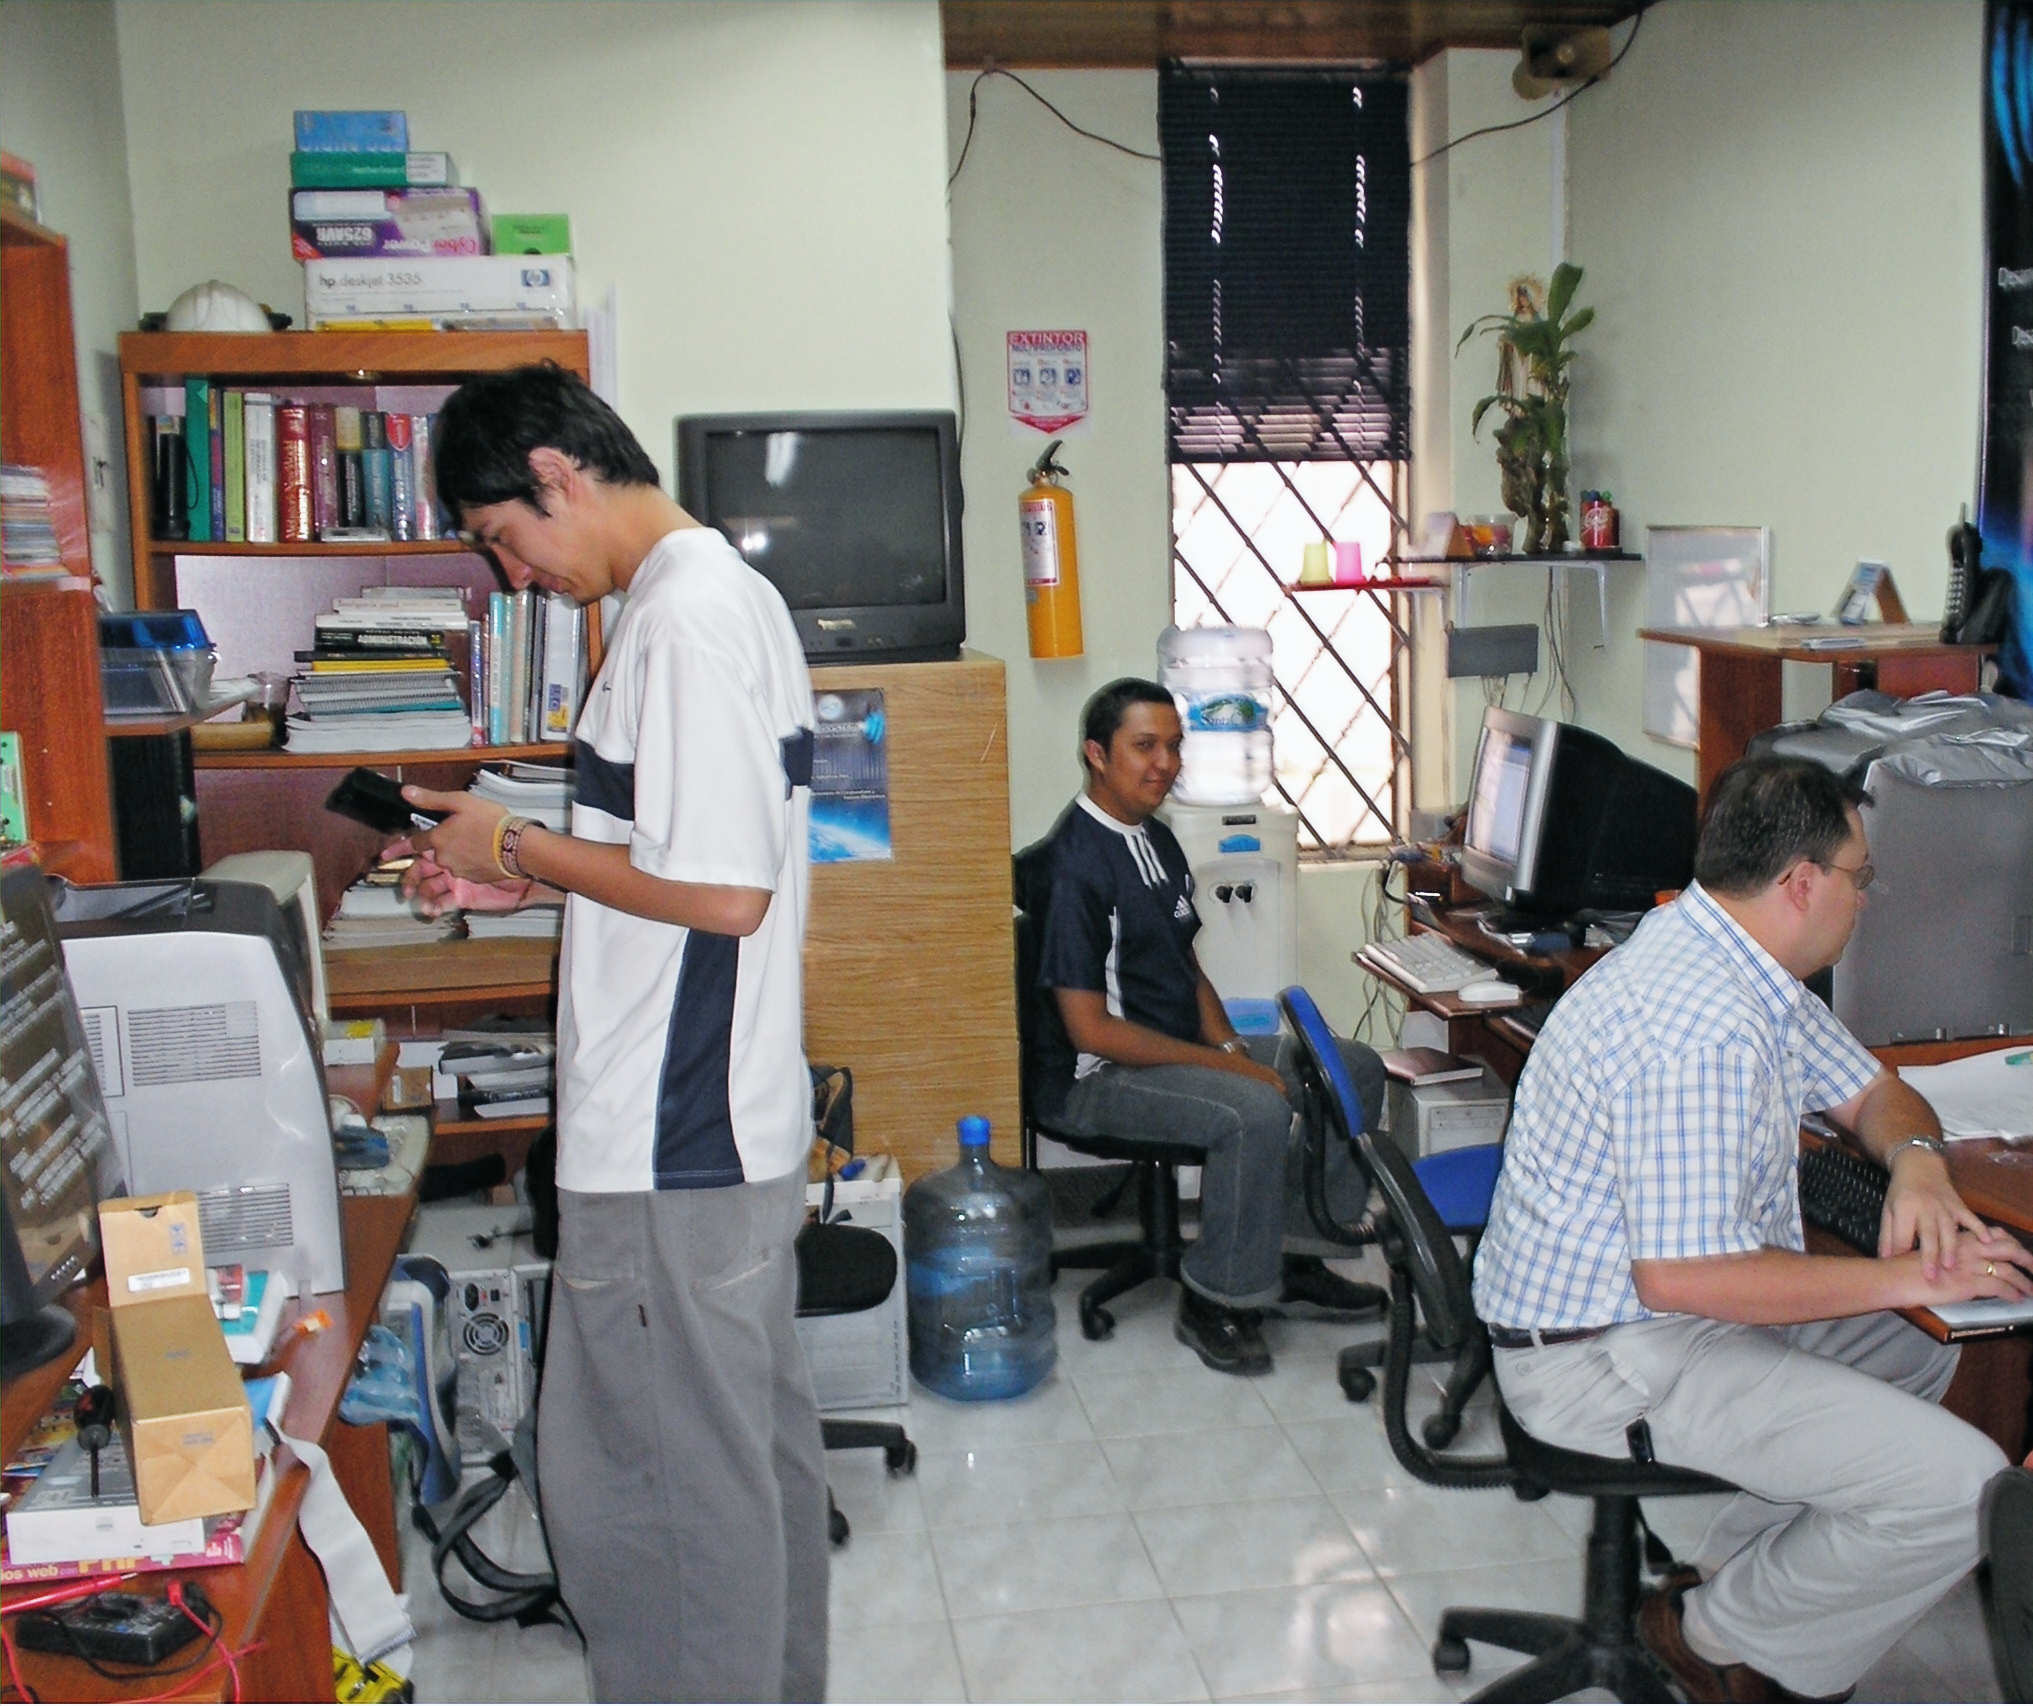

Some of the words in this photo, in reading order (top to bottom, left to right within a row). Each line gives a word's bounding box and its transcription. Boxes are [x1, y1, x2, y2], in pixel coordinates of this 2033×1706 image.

[319, 273, 336, 289] hp
[341, 273, 383, 288] deskjet
[387, 272, 421, 285] 3535
[1009, 332, 1085, 345] EXTINTOR
[27, 1565, 58, 1579] web
